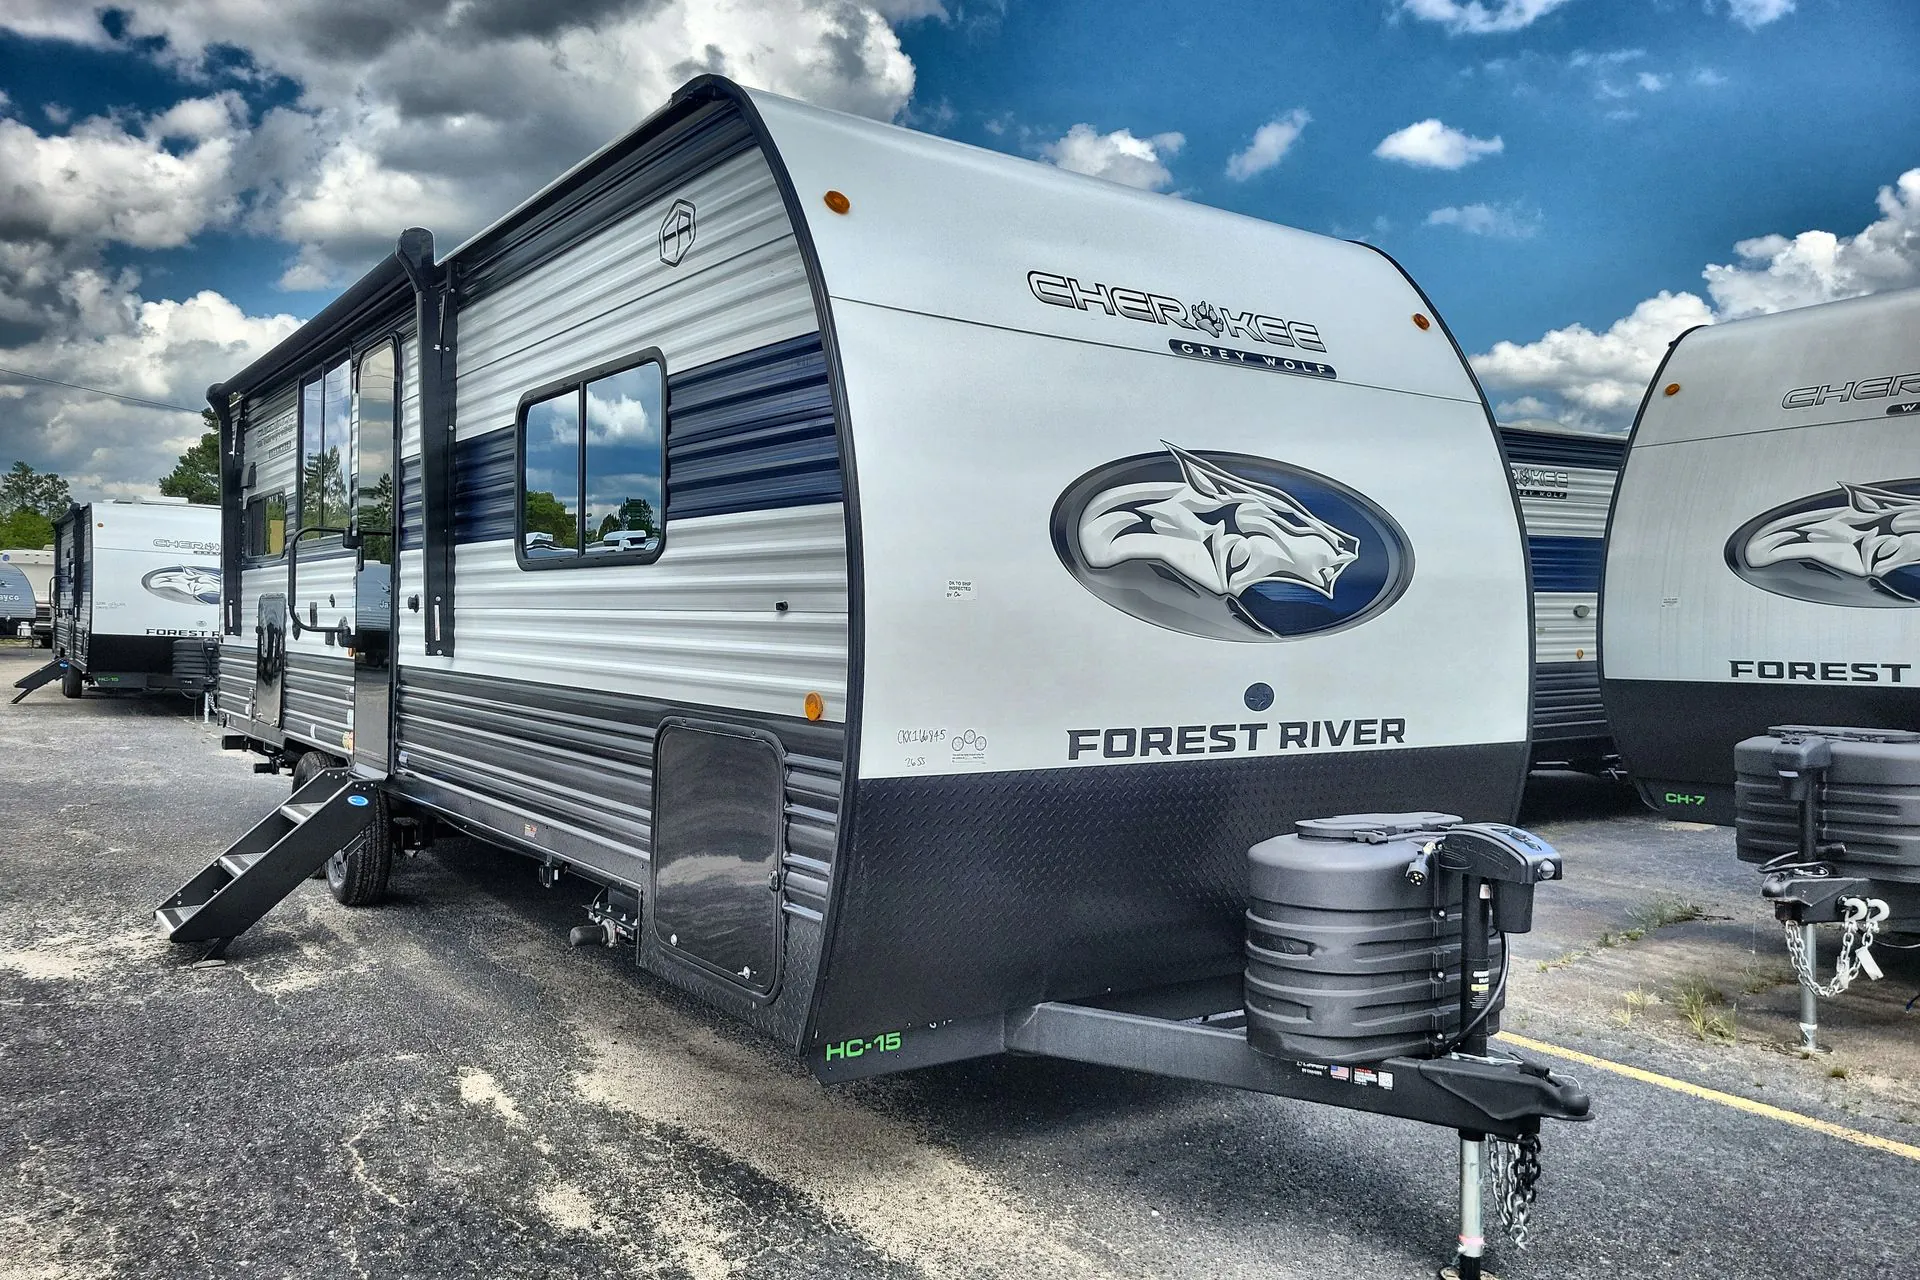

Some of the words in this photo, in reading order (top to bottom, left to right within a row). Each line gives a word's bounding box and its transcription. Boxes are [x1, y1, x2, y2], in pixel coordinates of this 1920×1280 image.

[1181, 343, 1249, 363] GREY
[1262, 356, 1329, 376] WOLF
[146, 629, 208, 637] FOREST
[1728, 660, 1912, 683] FOREST
[1065, 723, 1268, 760] FOREST
[1278, 718, 1405, 749] RIVER
[1665, 792, 1706, 805] CH-7
[826, 1032, 901, 1061] HC-15
